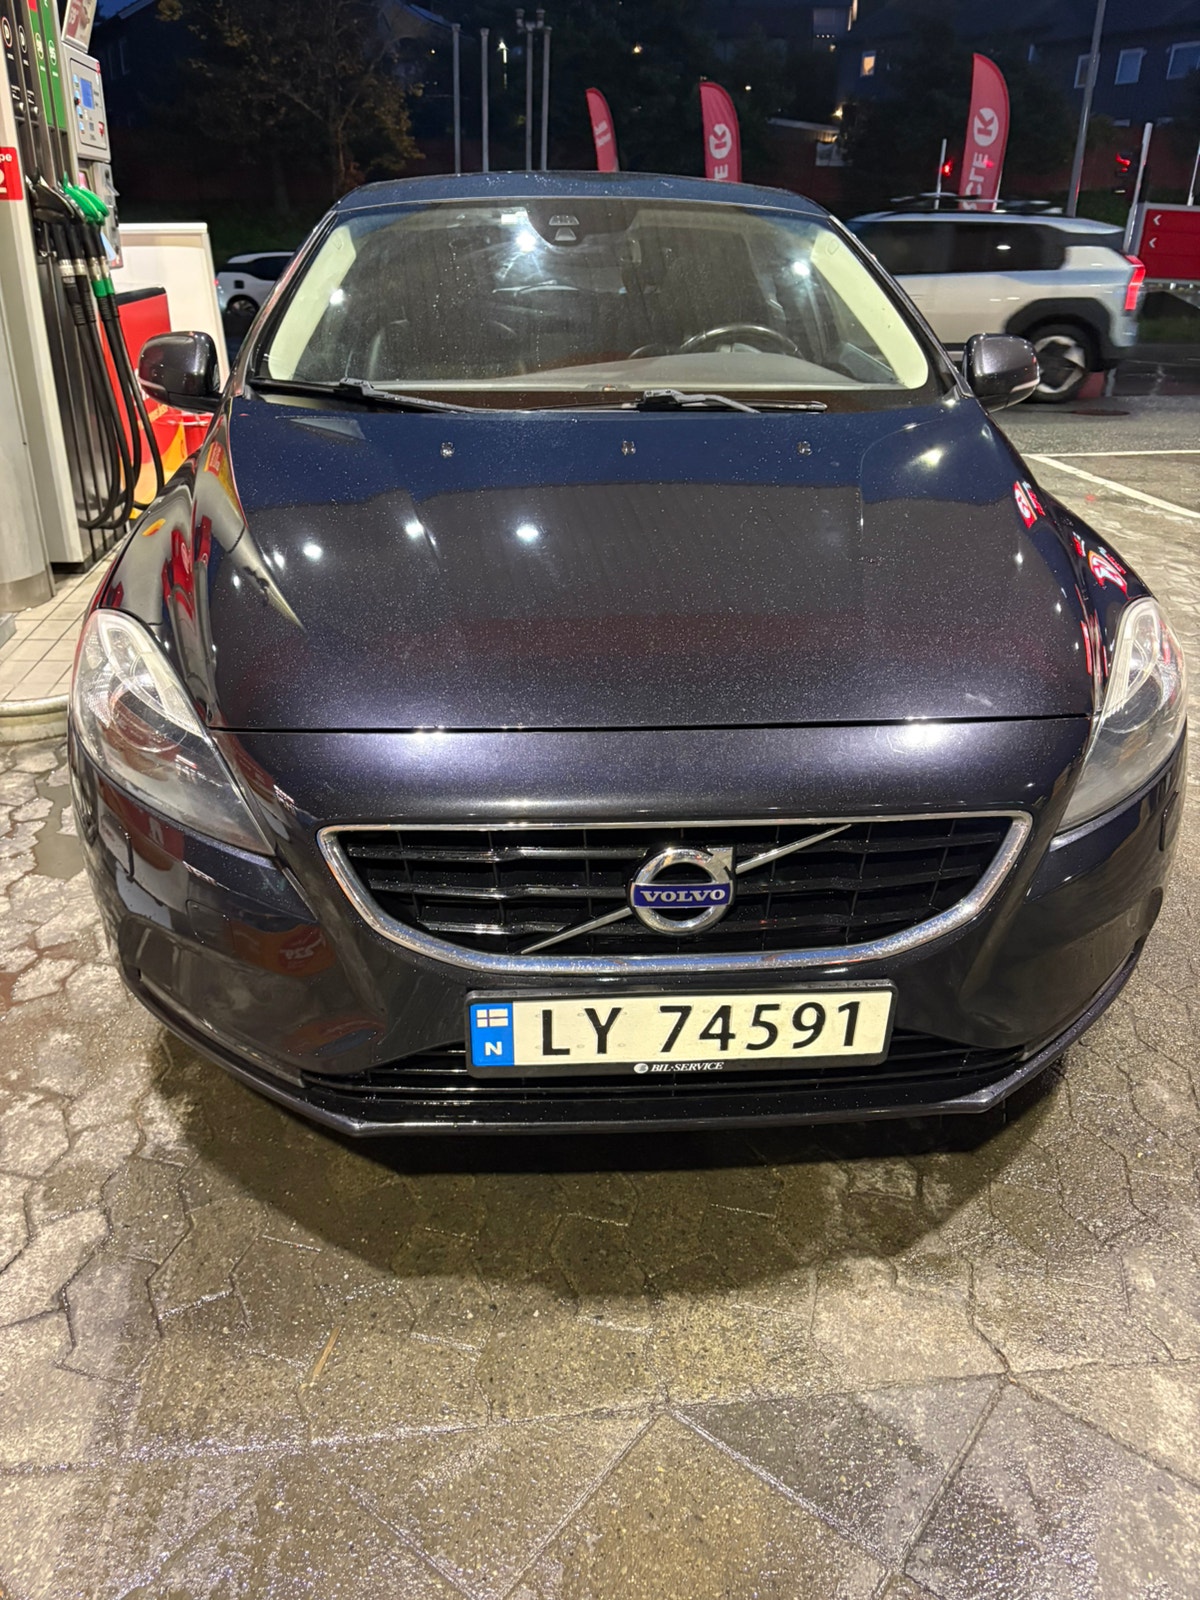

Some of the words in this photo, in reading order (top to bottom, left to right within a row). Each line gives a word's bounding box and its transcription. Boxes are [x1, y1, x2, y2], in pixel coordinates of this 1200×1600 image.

[710, 125, 730, 155] K
[974, 108, 998, 143] K
[640, 889, 726, 902] VOLVO
[542, 1007, 623, 1056] LY
[659, 1001, 861, 1053] 74591
[484, 1041, 503, 1056] N
